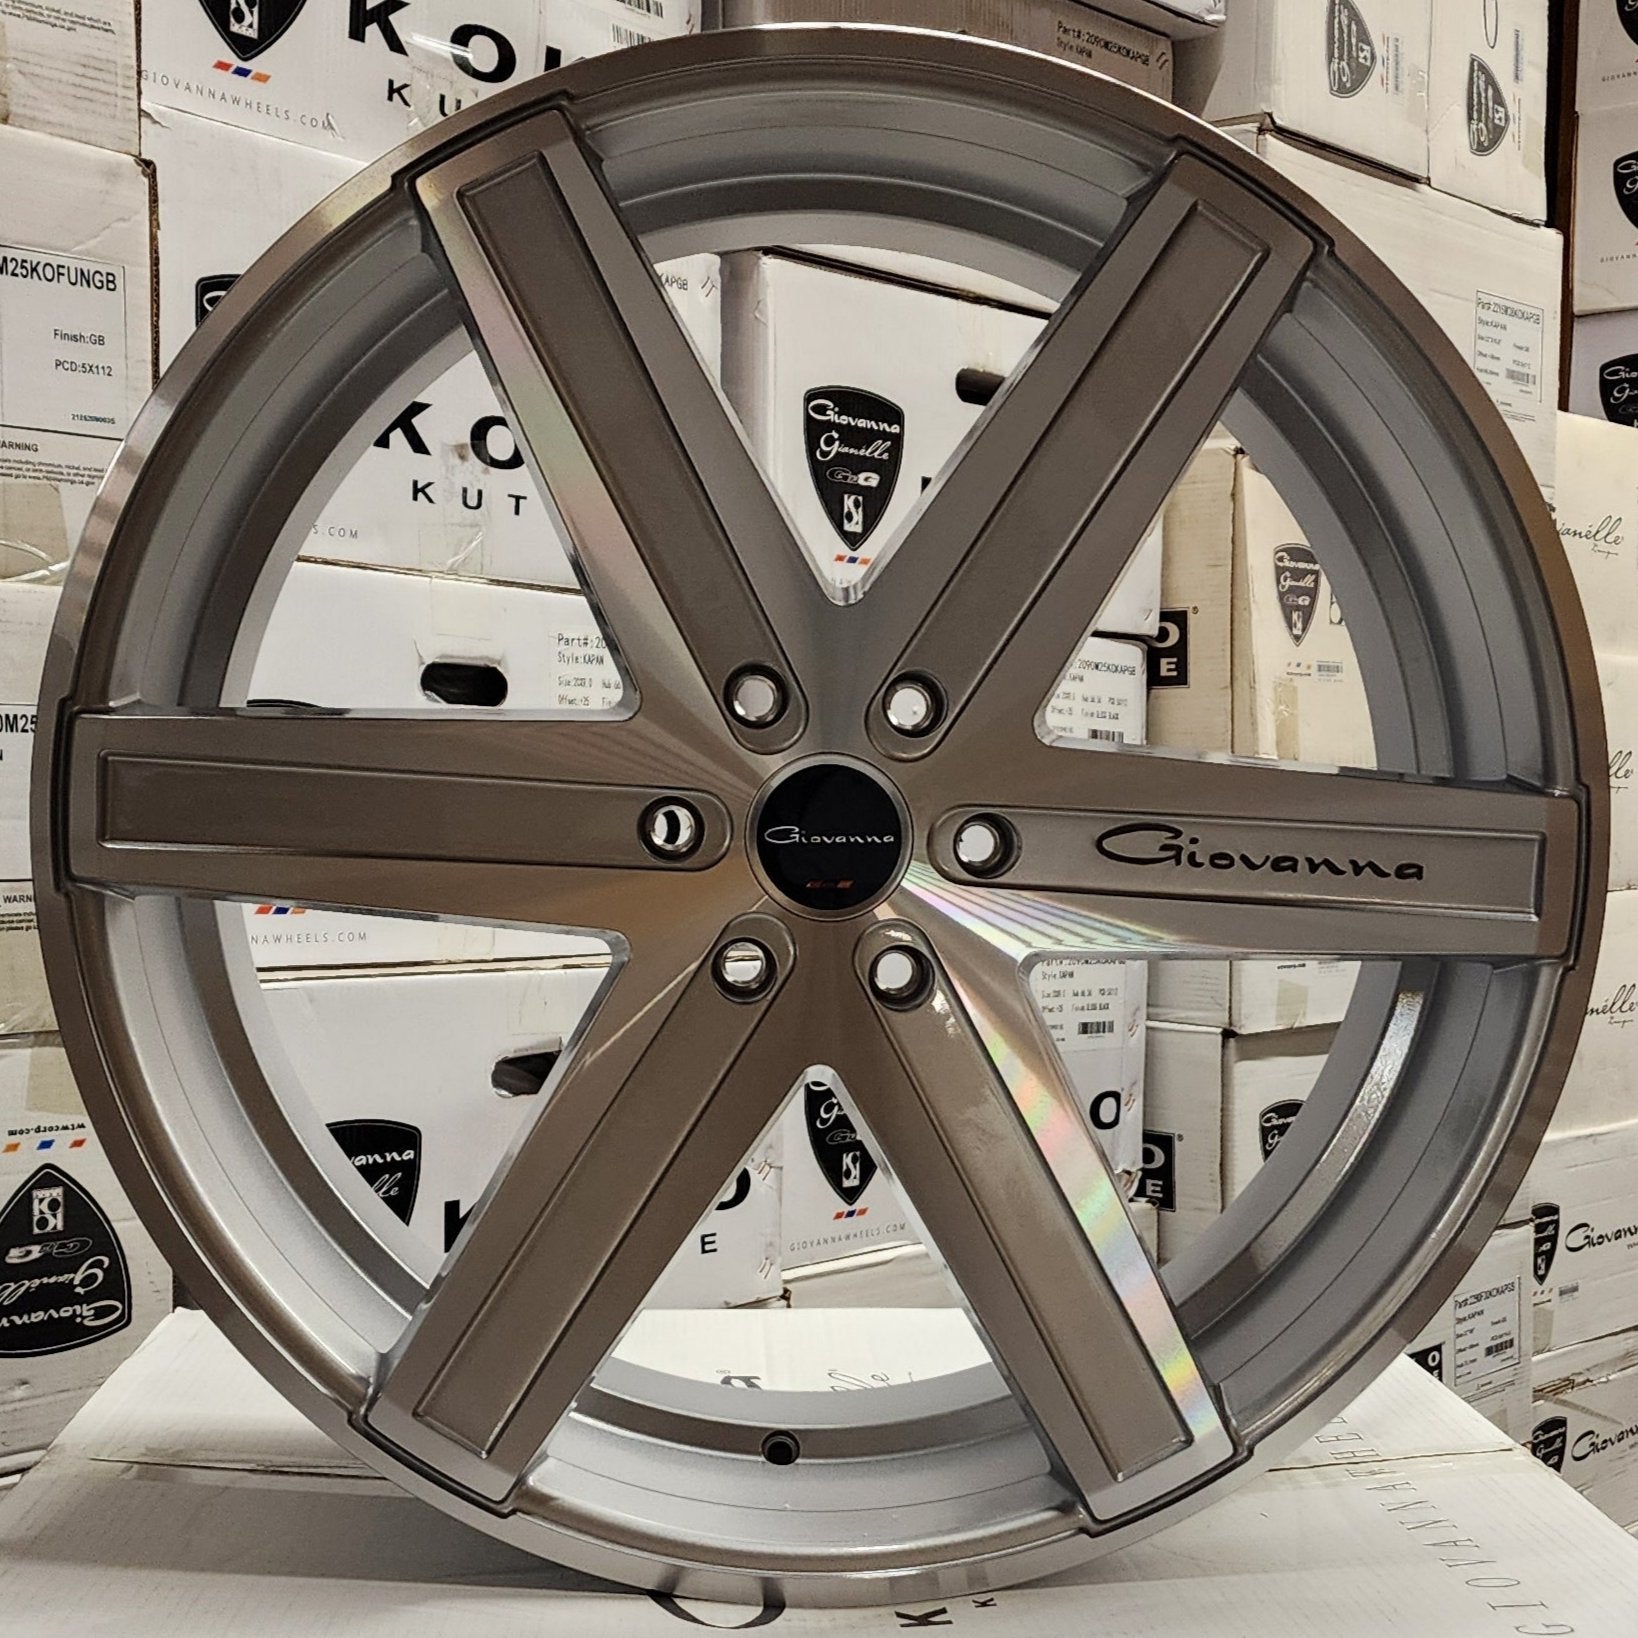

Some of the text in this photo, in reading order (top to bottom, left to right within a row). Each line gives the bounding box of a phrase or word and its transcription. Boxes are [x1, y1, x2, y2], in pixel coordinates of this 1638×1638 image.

[53, 328, 106, 346] Finish:GB
[54, 358, 113, 377] PCD:5X112
[808, 399, 900, 434] Giovanna
[0, 440, 39, 453] ARNING
[764, 825, 895, 844] Giovanna
[1096, 822, 1425, 881] Giovanna
[250, 931, 368, 945] NAWHEELS.COM
[7, 1122, 87, 1137] wtwcorp.com
